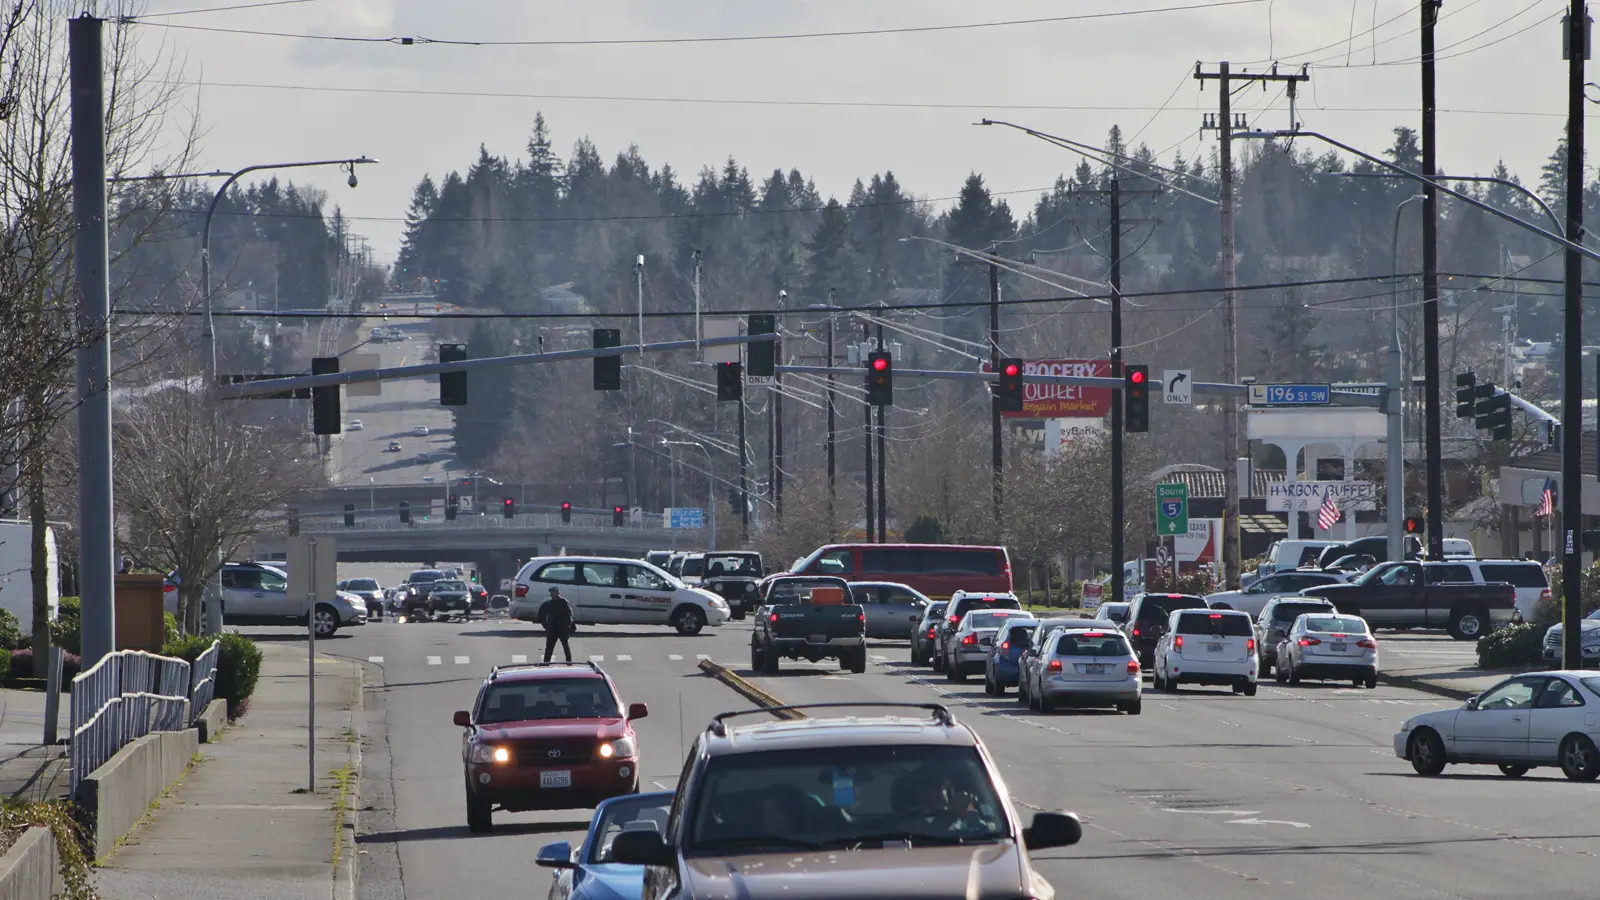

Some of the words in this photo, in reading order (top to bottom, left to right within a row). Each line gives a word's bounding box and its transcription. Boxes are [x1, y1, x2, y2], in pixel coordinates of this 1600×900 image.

[1022, 363, 1096, 378] ROCERY
[748, 376, 771, 384] ONLY
[1024, 383, 1084, 400] OUTLET
[1269, 387, 1295, 401] 196
[1299, 391, 1310, 401] St
[1311, 390, 1326, 401] SW
[1166, 394, 1189, 403] ONLY
[1022, 402, 1057, 416] argain
[1060, 426, 1102, 437] eyBank
[1270, 484, 1320, 497] HARBOR
[1327, 484, 1374, 497] BUFFET
[1168, 503, 1177, 516] 5
[1189, 523, 1207, 532] LEASE
